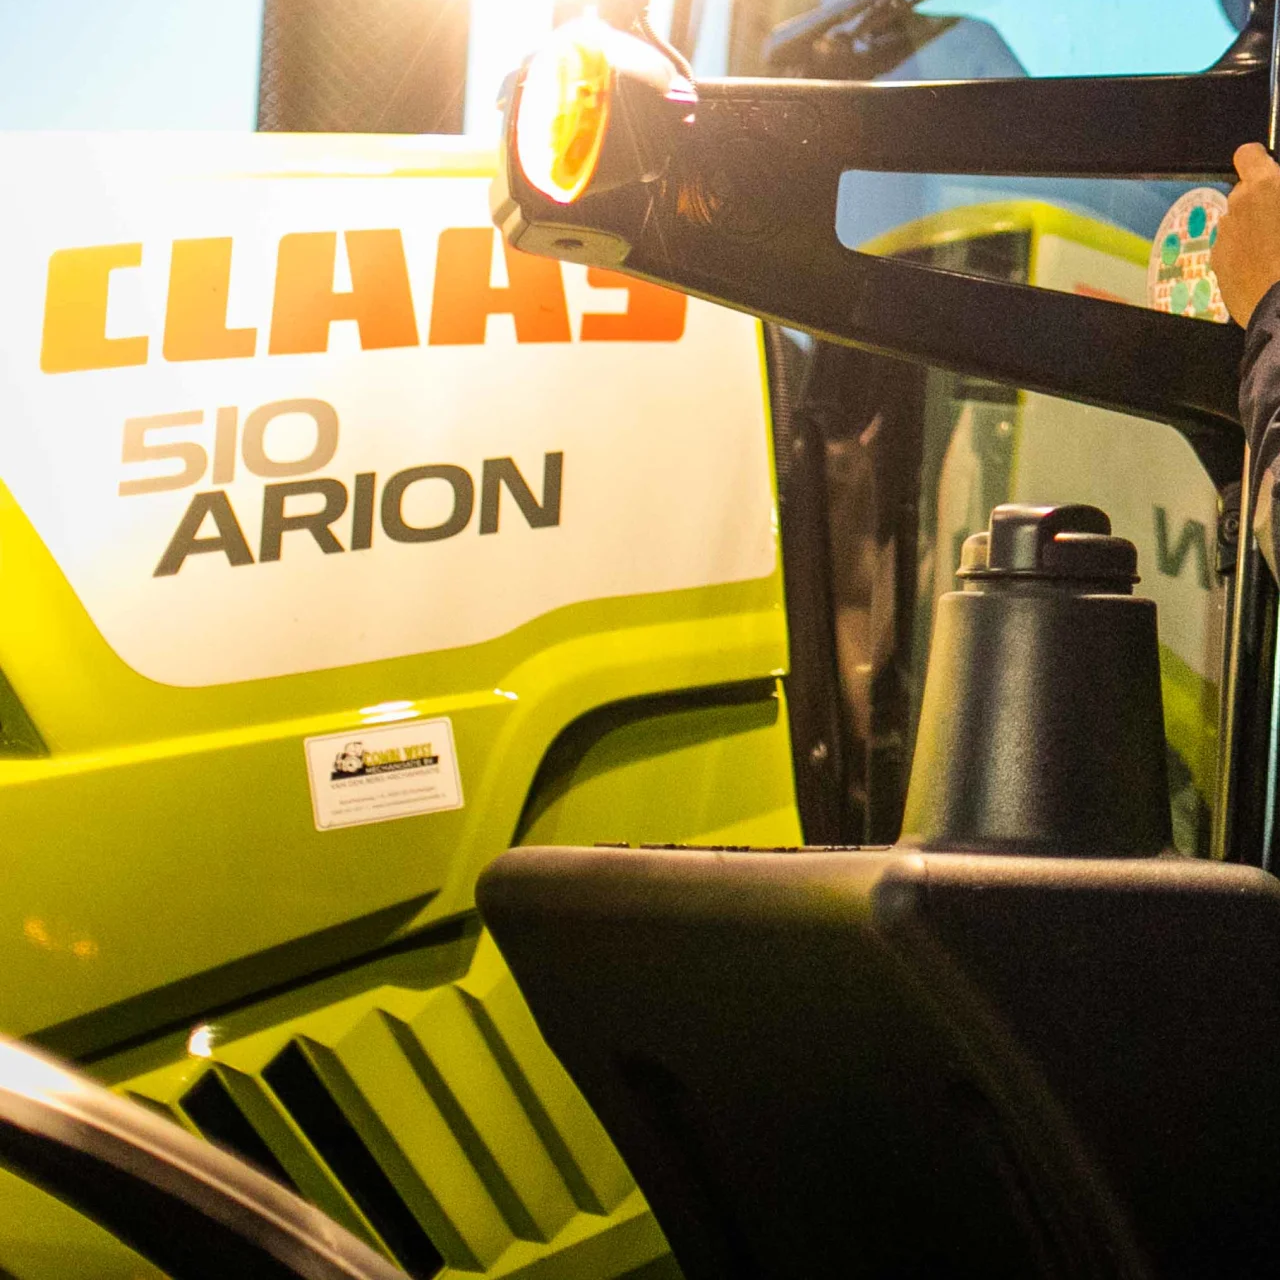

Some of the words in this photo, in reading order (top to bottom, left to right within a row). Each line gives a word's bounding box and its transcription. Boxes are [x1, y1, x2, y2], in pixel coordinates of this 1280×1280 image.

[40, 227, 689, 375] CLAAS
[118, 397, 340, 497] 510
[152, 451, 564, 578] ARION
